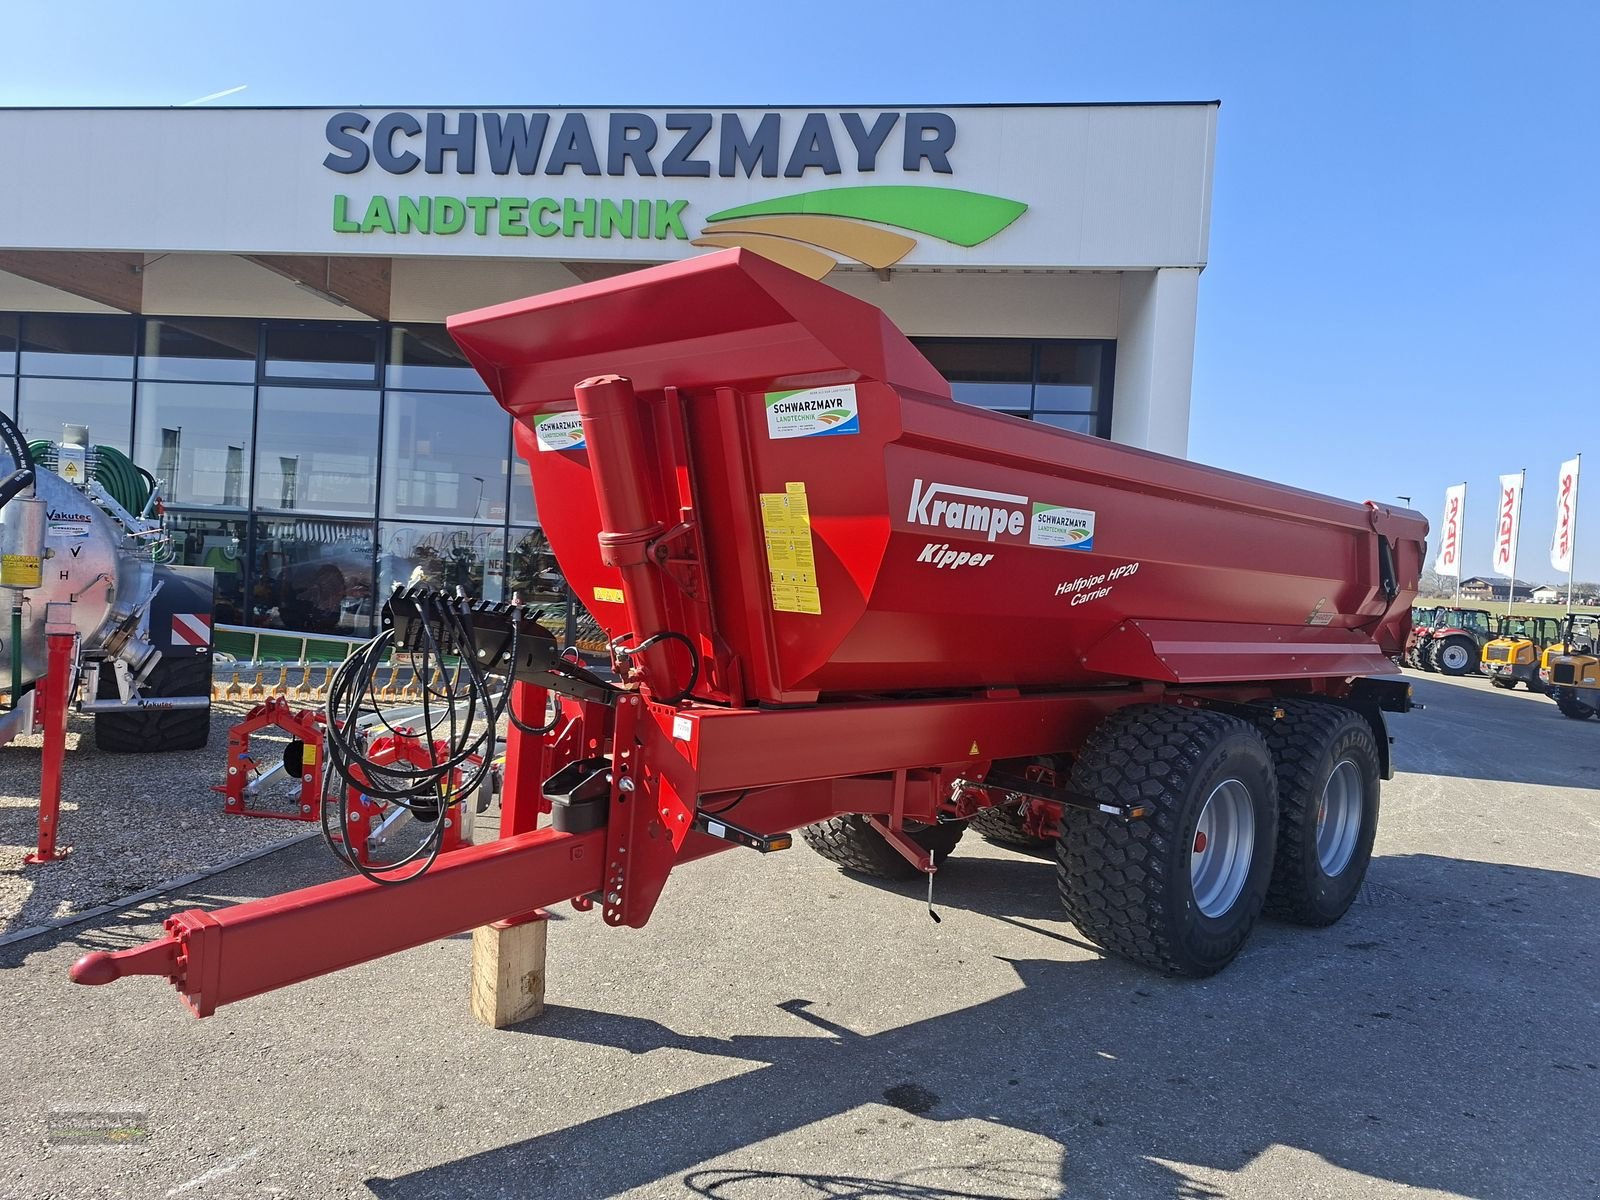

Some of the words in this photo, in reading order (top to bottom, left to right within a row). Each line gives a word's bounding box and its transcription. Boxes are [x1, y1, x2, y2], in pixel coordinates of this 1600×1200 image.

[323, 110, 956, 179] SCHWARZMAYR
[333, 194, 690, 241] LANDTECHNIK
[773, 398, 843, 414] SCHWARZMAYR
[540, 420, 583, 431] SCHWARZMAYR
[776, 414, 816, 423] LANDTECHNIK
[46, 509, 92, 523] Vakutec
[907, 479, 1029, 543] Krampe
[1038, 513, 1087, 528] SCHWARZMAYR
[1038, 525, 1067, 534] LANDTECHNIK
[916, 543, 995, 570] Kipper
[59, 570, 69, 580] H
[1054, 573, 1105, 597] Halfpipe
[1107, 561, 1139, 581] HP20
[70, 593, 78, 603] L
[1070, 585, 1113, 607] Carrier
[138, 700, 173, 711] Vakutec
